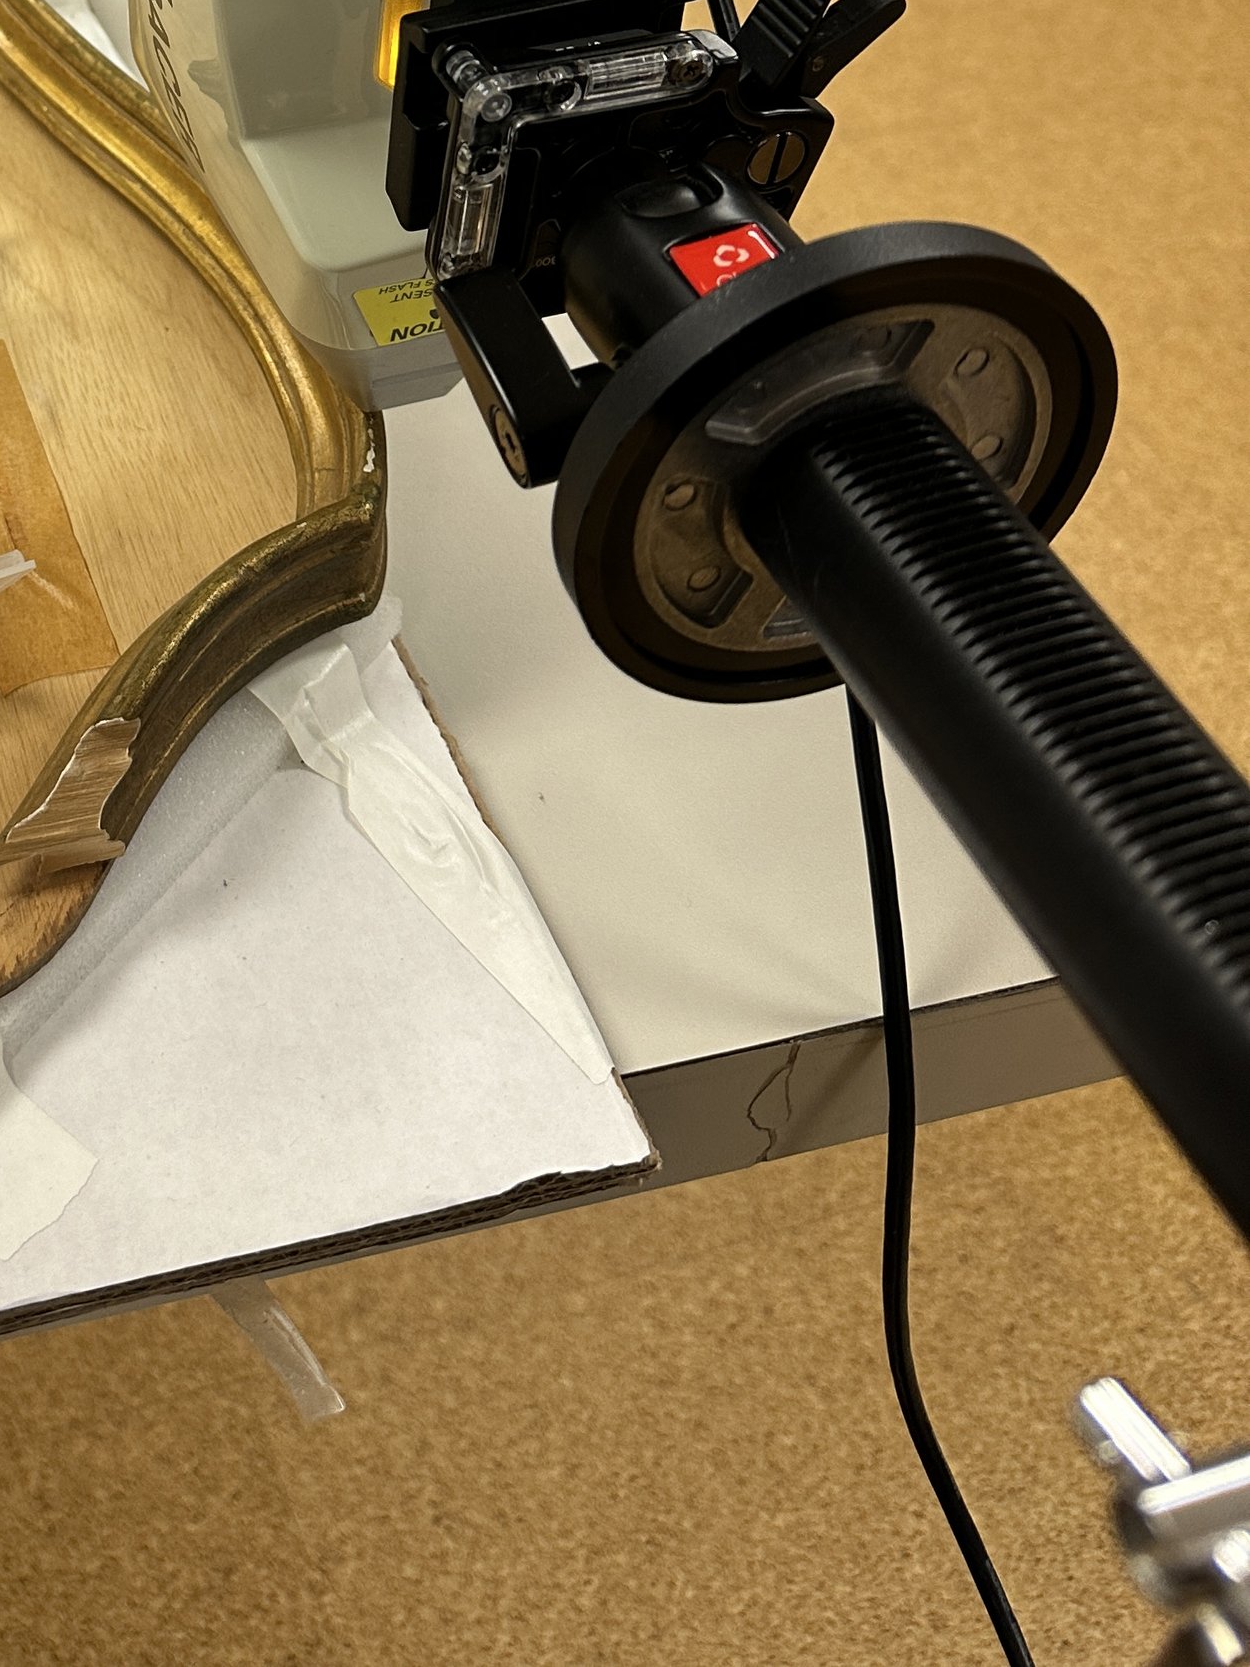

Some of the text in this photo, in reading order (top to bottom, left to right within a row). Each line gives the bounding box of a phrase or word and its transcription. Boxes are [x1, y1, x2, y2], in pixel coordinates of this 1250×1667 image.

[378, 280, 422, 295] FLASH
[389, 288, 433, 304] SENT
[389, 321, 444, 342] TION
